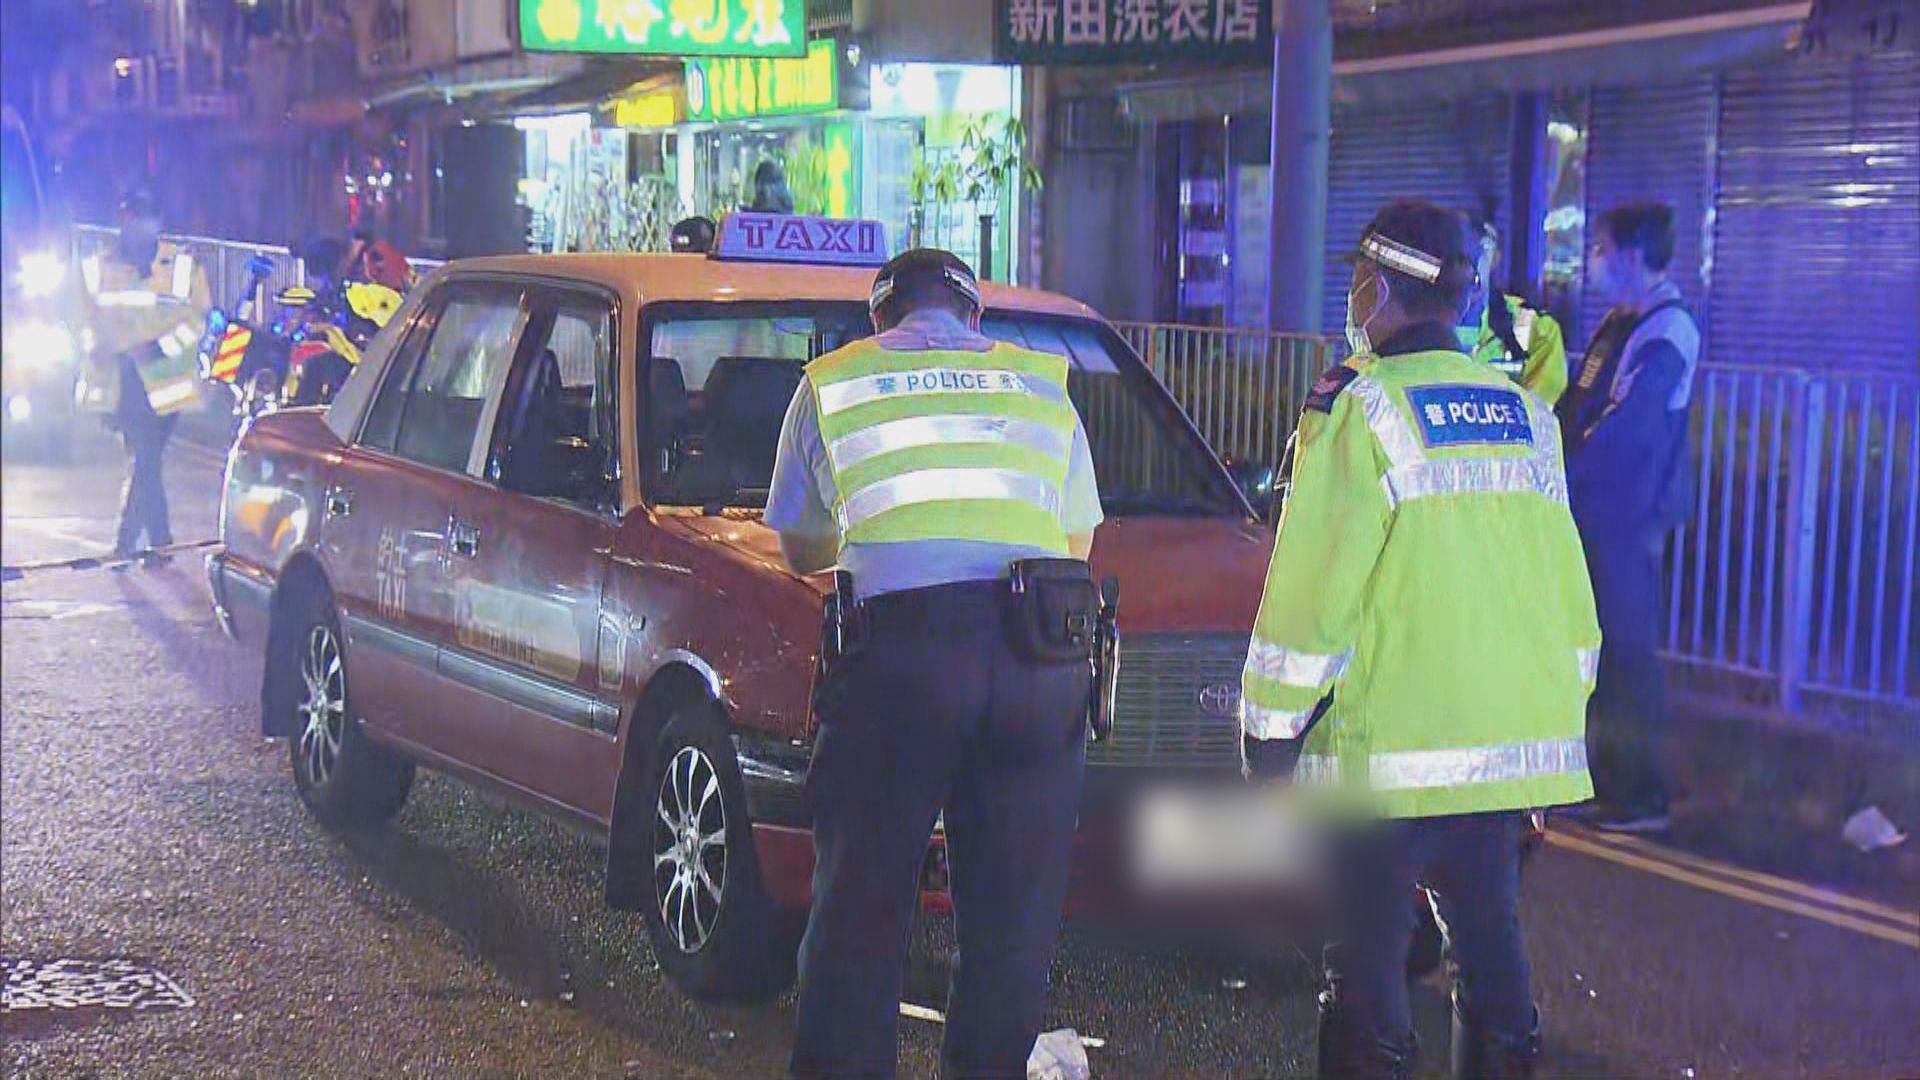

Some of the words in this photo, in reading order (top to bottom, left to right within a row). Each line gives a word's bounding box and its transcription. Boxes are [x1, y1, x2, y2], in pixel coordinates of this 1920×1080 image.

[738, 218, 875, 252] TAXI
[907, 371, 989, 391] POLICE
[1448, 402, 1516, 424] POLICE
[376, 571, 407, 618] TAXI
